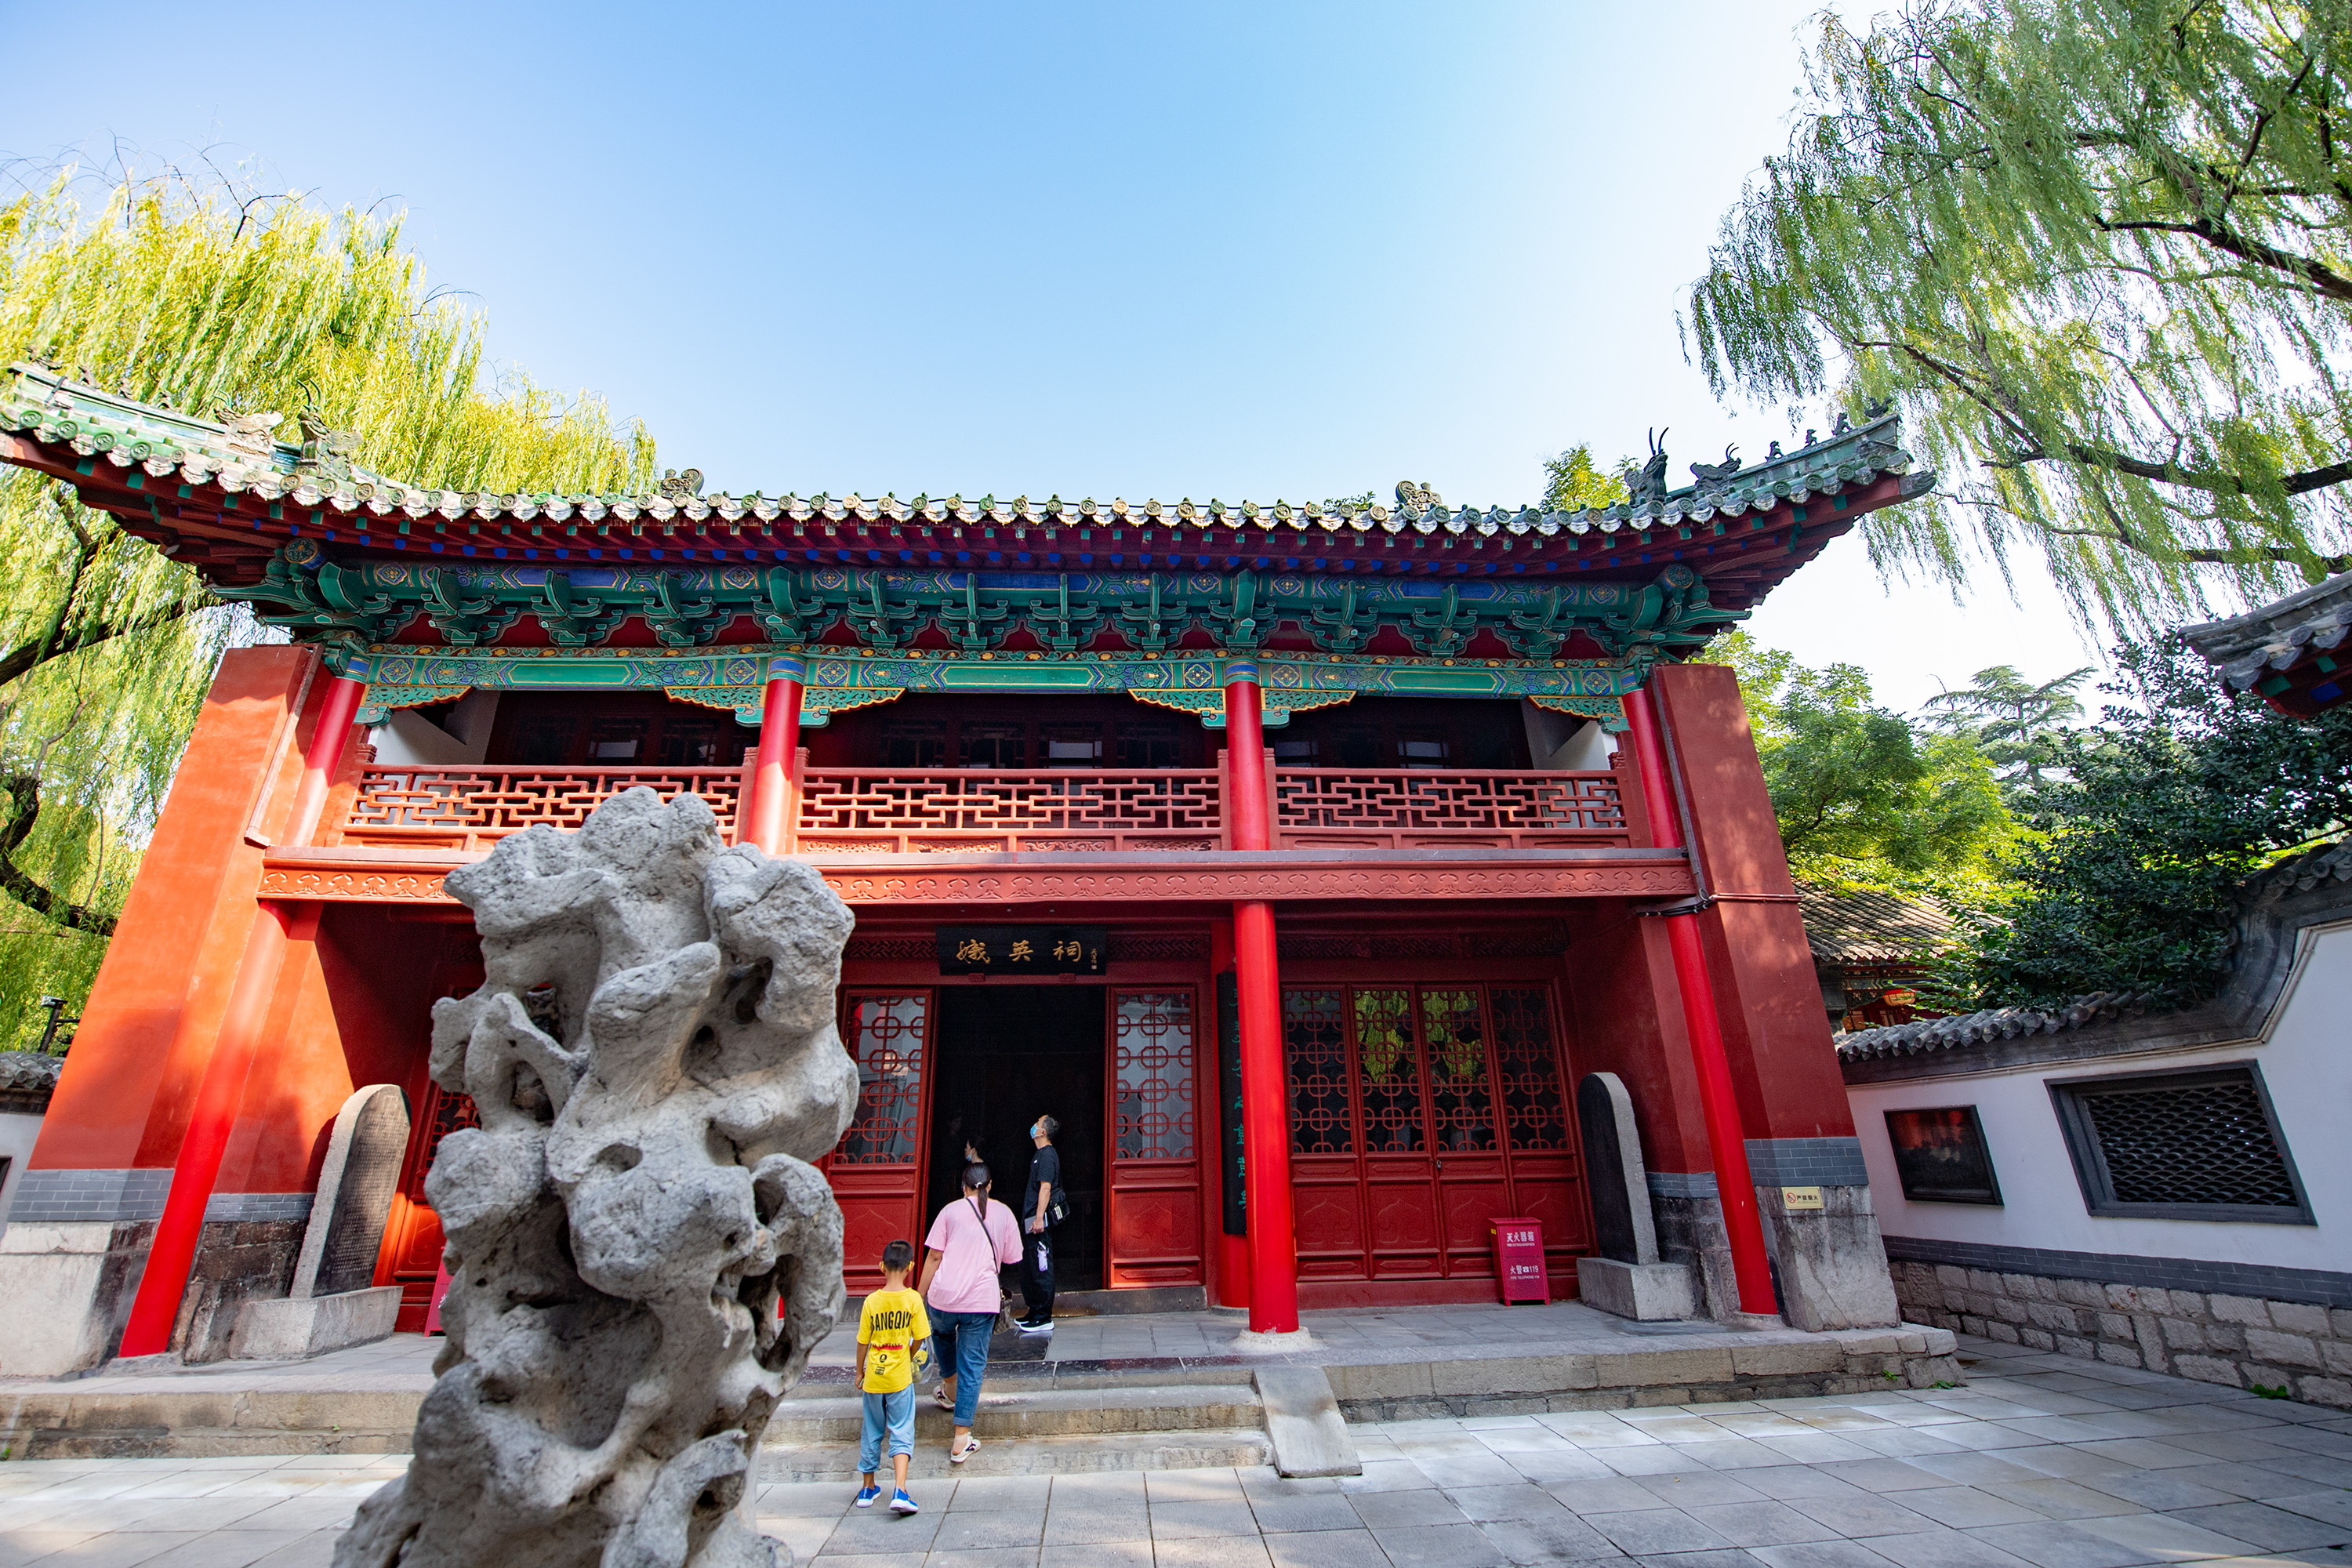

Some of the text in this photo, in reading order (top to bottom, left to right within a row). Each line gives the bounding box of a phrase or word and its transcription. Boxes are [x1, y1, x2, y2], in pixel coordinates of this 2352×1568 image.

[1506, 1231, 1534, 1242] 灭火器箱
[1510, 1265, 1539, 1275] 火警 119
